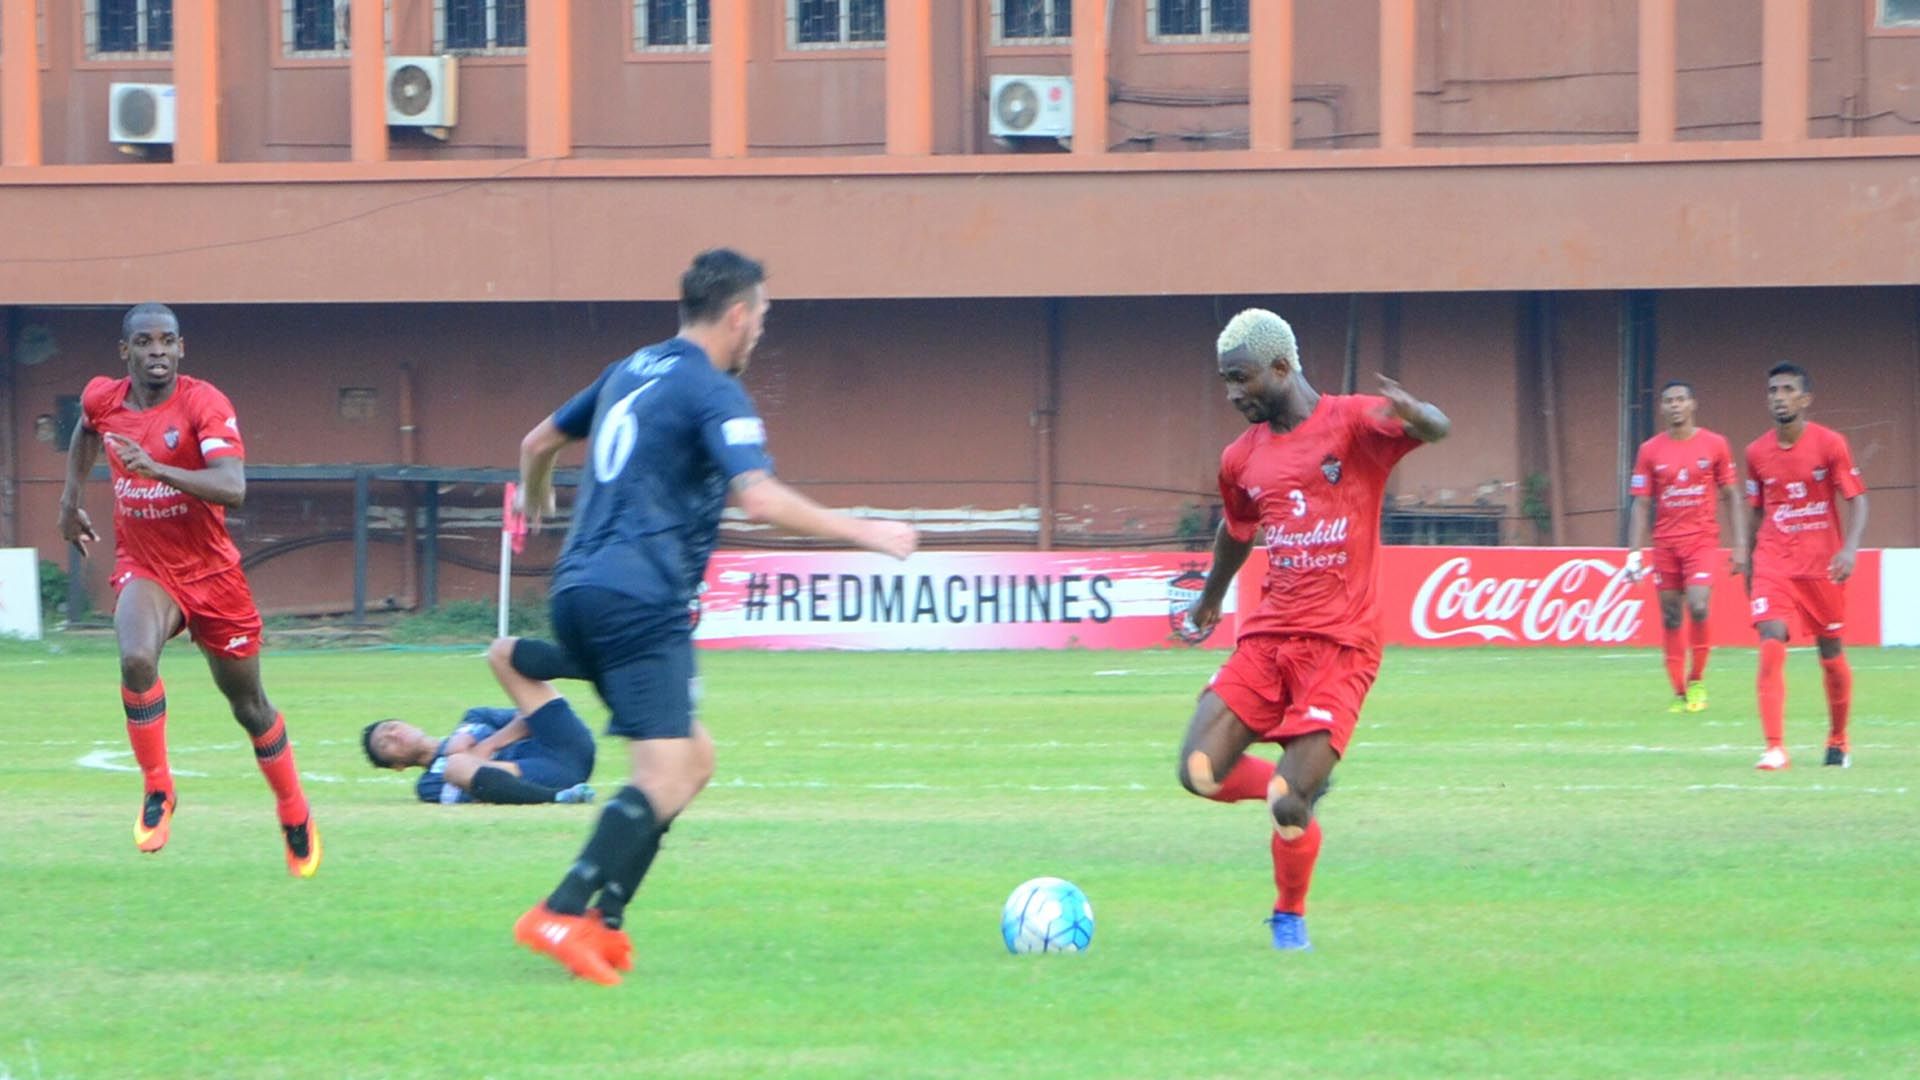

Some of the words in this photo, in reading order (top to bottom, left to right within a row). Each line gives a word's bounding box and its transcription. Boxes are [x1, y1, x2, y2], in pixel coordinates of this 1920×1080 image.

[594, 377, 661, 483] 6
[1289, 489, 1306, 517] 3
[1785, 481, 1808, 499] 33
[1264, 517, 1348, 547] Churchill
[745, 571, 1113, 624] #REDMACHINES
[1411, 557, 1653, 643] Coca-Cola
